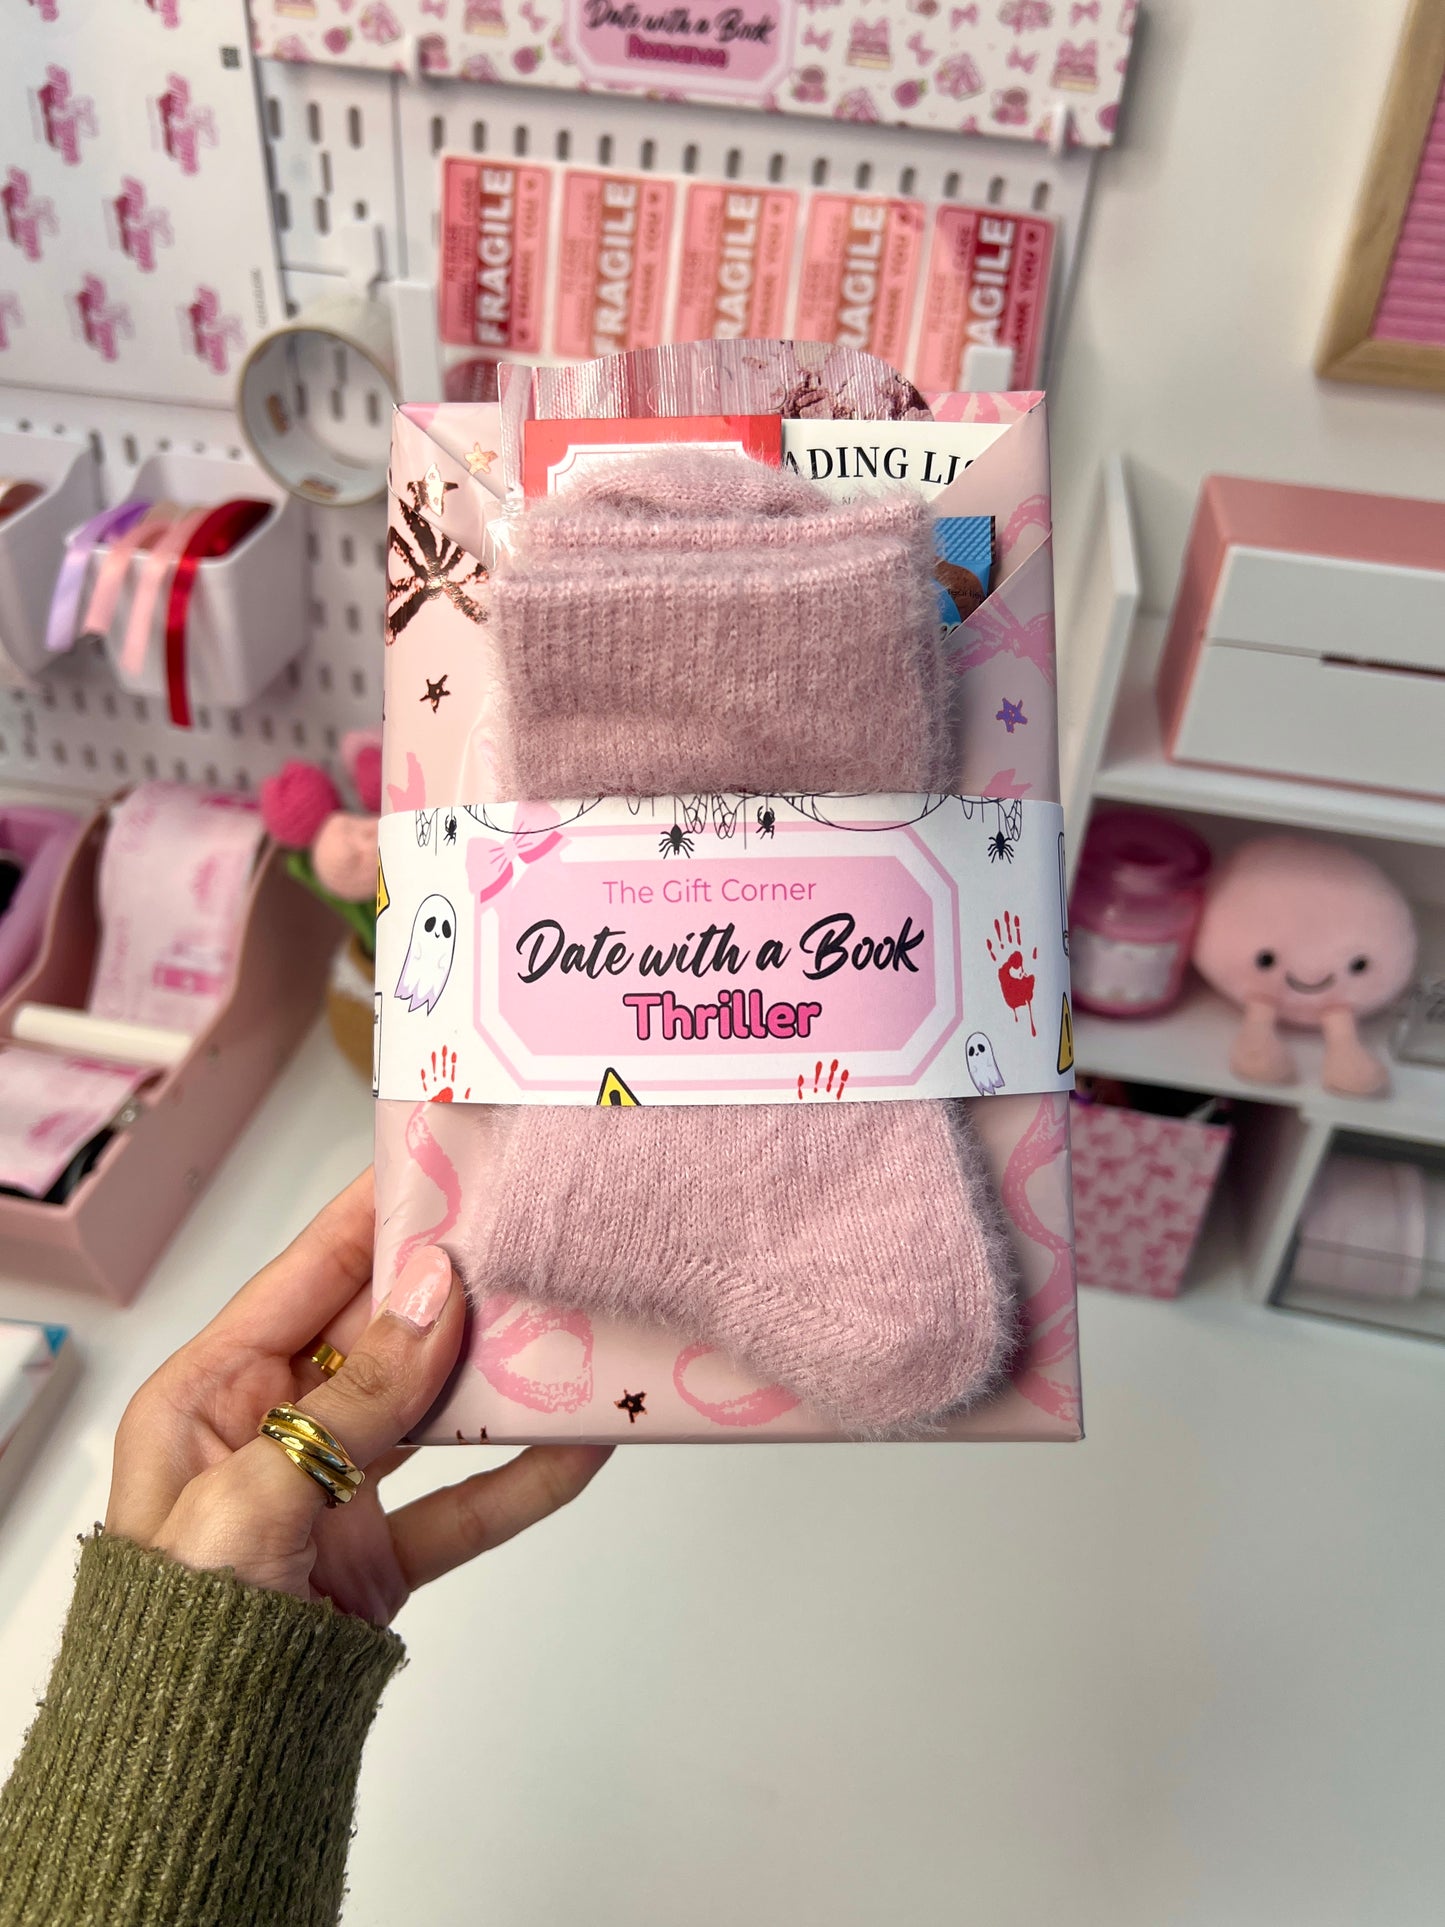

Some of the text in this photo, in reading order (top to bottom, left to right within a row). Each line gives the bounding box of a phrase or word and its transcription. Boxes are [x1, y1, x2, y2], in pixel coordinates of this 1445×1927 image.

[475, 167, 514, 343] FRAGILE
[592, 182, 636, 354] FRAGILE
[713, 193, 760, 340] RAGILE
[835, 203, 886, 349] RAGILE
[966, 216, 1014, 347] AGILE
[783, 446, 909, 480] ADING
[516, 912, 925, 984] Date with a Book
[603, 878, 817, 904] The Gift Corner
[623, 989, 823, 1041] Thriller
